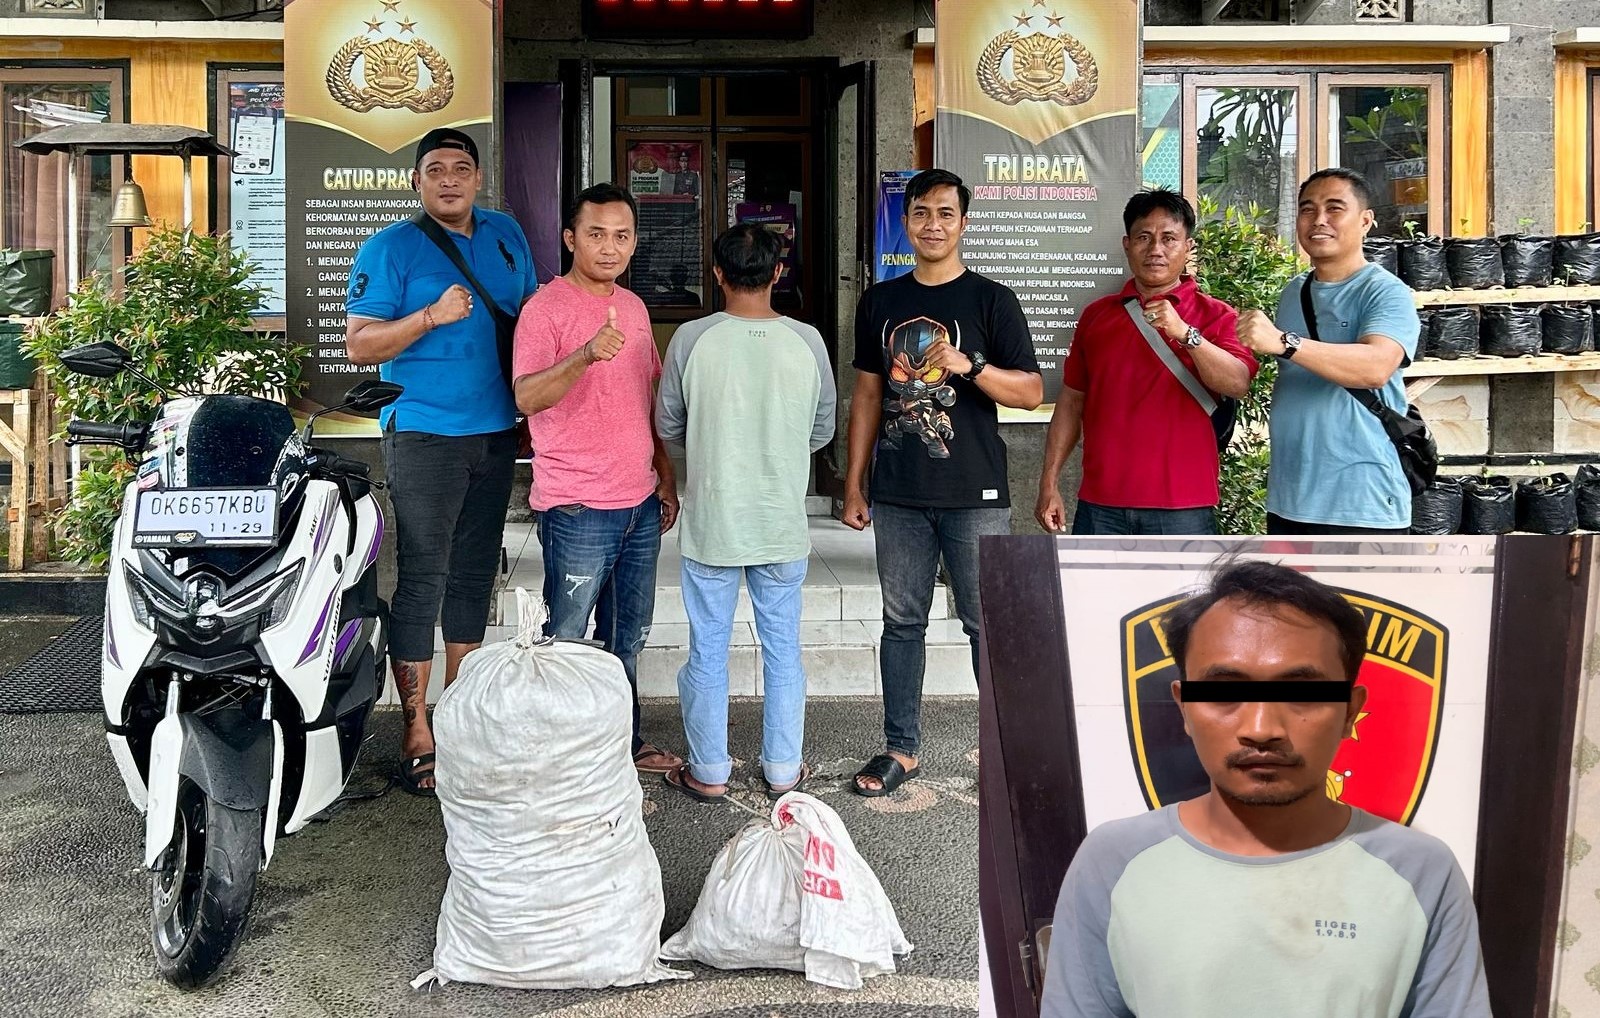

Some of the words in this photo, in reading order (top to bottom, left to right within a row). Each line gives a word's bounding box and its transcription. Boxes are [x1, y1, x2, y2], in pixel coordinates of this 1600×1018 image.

[983, 153, 1018, 184] TRI
[1021, 154, 1090, 184] BRATA
[323, 166, 376, 191] CATUR
[974, 185, 1002, 200] KAMI
[1003, 186, 1038, 201] POLISI
[1040, 186, 1098, 201] INDONESIA
[305, 199, 340, 208] SEBAGAI
[341, 199, 364, 208] INSAN
[366, 199, 422, 208] BHAYANGKARA
[305, 213, 358, 222] KEHORMATAN
[359, 213, 379, 222] SAYA
[965, 211, 996, 219] ERBAKTI
[997, 211, 1022, 219] KEPADA
[1023, 211, 1042, 219] NUSA
[1058, 212, 1087, 220] BANGSA
[305, 227, 354, 236] BERKORBAN
[355, 227, 374, 236] DEMI
[991, 224, 1014, 233] PENUH
[1014, 225, 1056, 233] KETAQWAAN
[1057, 225, 1093, 234] TERHADAP
[305, 241, 322, 250] DAN
[323, 241, 356, 250] NEGARA
[962, 238, 985, 246] TUHAN
[986, 238, 1004, 246] YANG
[1005, 238, 1025, 247] MAHA
[1025, 239, 1039, 247] ESA
[962, 252, 1007, 260] MENJUNJUNG
[1007, 252, 1030, 260] TINGGI
[1030, 252, 1073, 261] KEBENARAN,
[1074, 253, 1107, 261] KEADILAN
[306, 257, 314, 266] 1.
[318, 257, 355, 266] MENIADA
[966, 265, 976, 273] AN
[977, 266, 1025, 274] KEMANUSIAAN
[1026, 266, 1049, 274] DALAM
[1051, 267, 1098, 275] MENEGAKKAN
[1099, 267, 1124, 275] HUKUM
[351, 272, 370, 299] 3
[1026, 280, 1059, 288] REPUBLIK
[1060, 280, 1096, 289] INDONESIA
[306, 287, 314, 297] 2.
[318, 287, 349, 297] MENJA
[1031, 293, 1069, 302] PANCASILA
[318, 302, 346, 312] HARTA
[1035, 307, 1058, 315] DASAR
[1060, 307, 1075, 315] 1945
[306, 318, 314, 327] 3.
[318, 318, 348, 327] MENJA
[318, 333, 347, 343] BERDA
[1031, 334, 1055, 342] RAKAT
[318, 348, 348, 358] MEMEL
[318, 363, 358, 373] TENTRAM
[143, 535, 171, 543] YAMAHA
[1315, 919, 1357, 931] EIGER
